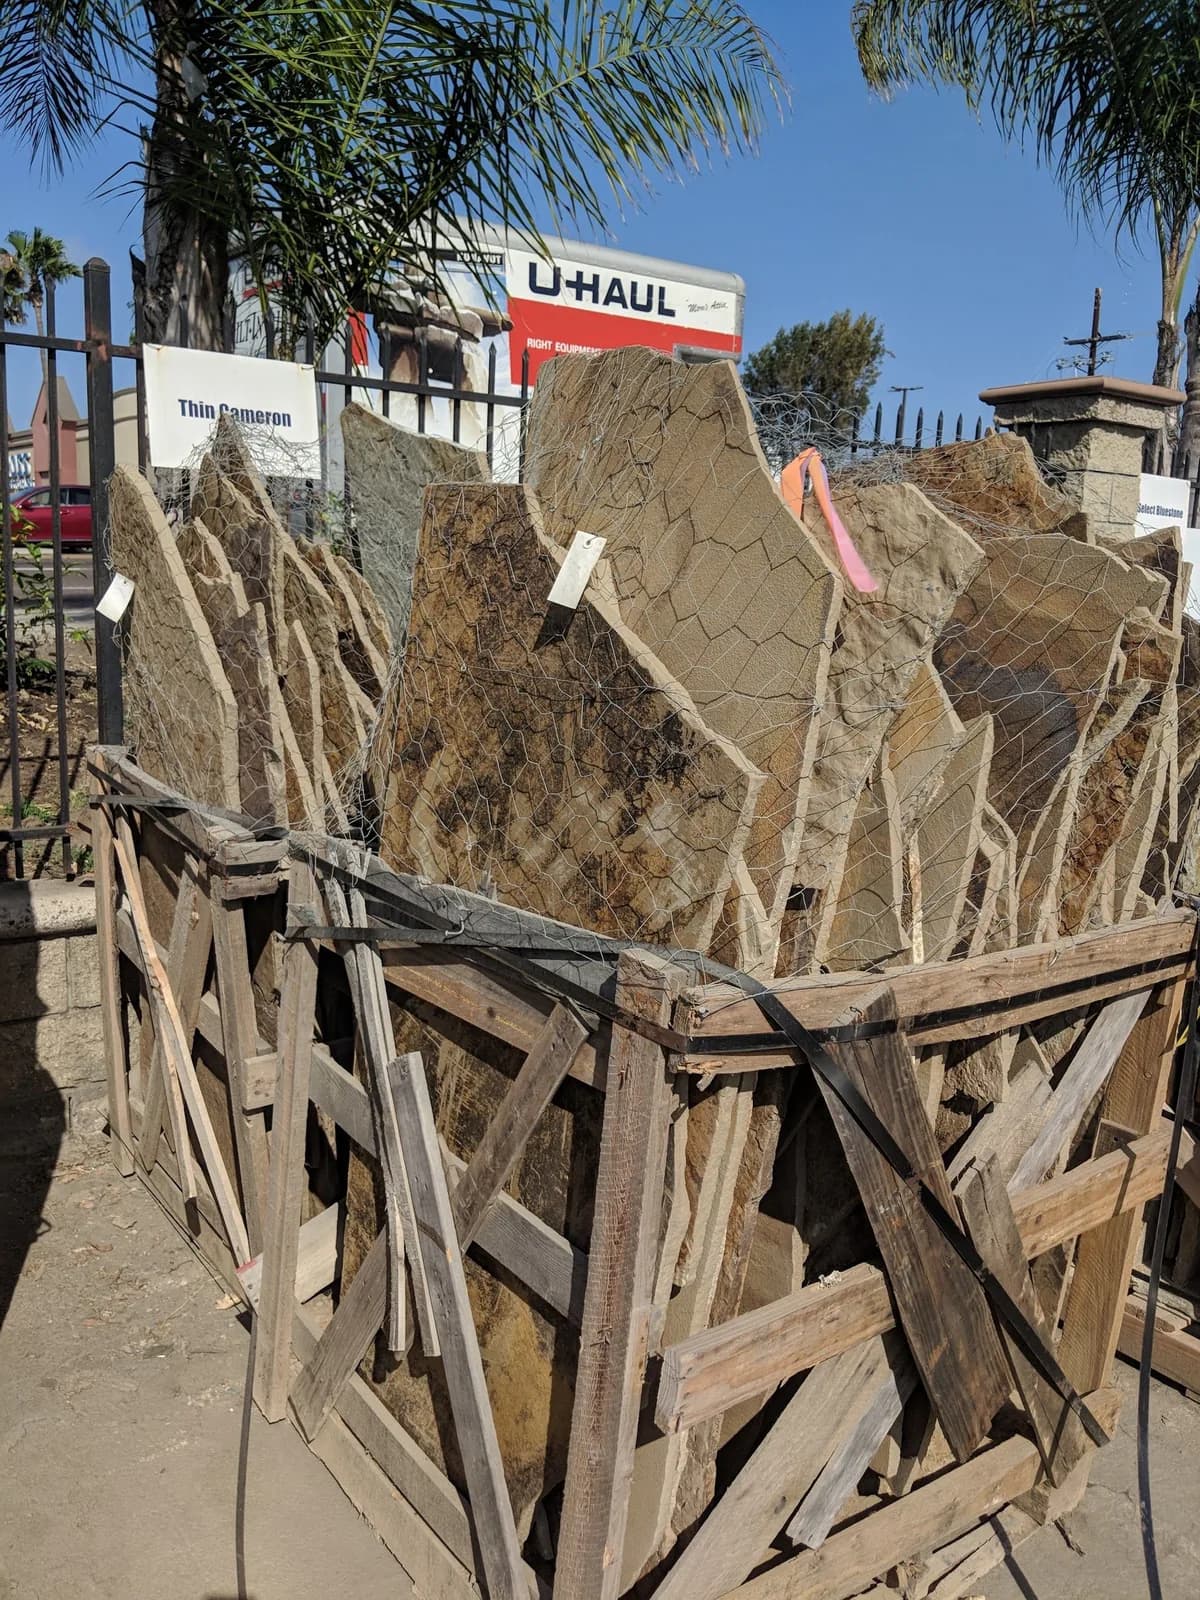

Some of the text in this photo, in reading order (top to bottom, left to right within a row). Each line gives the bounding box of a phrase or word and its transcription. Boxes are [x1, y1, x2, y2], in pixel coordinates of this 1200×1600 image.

[528, 261, 676, 318] U-HAUL
[527, 337, 553, 351] RIGHT
[178, 399, 292, 427] Thin Cameron
[1137, 503, 1183, 518] Select Bluestone
